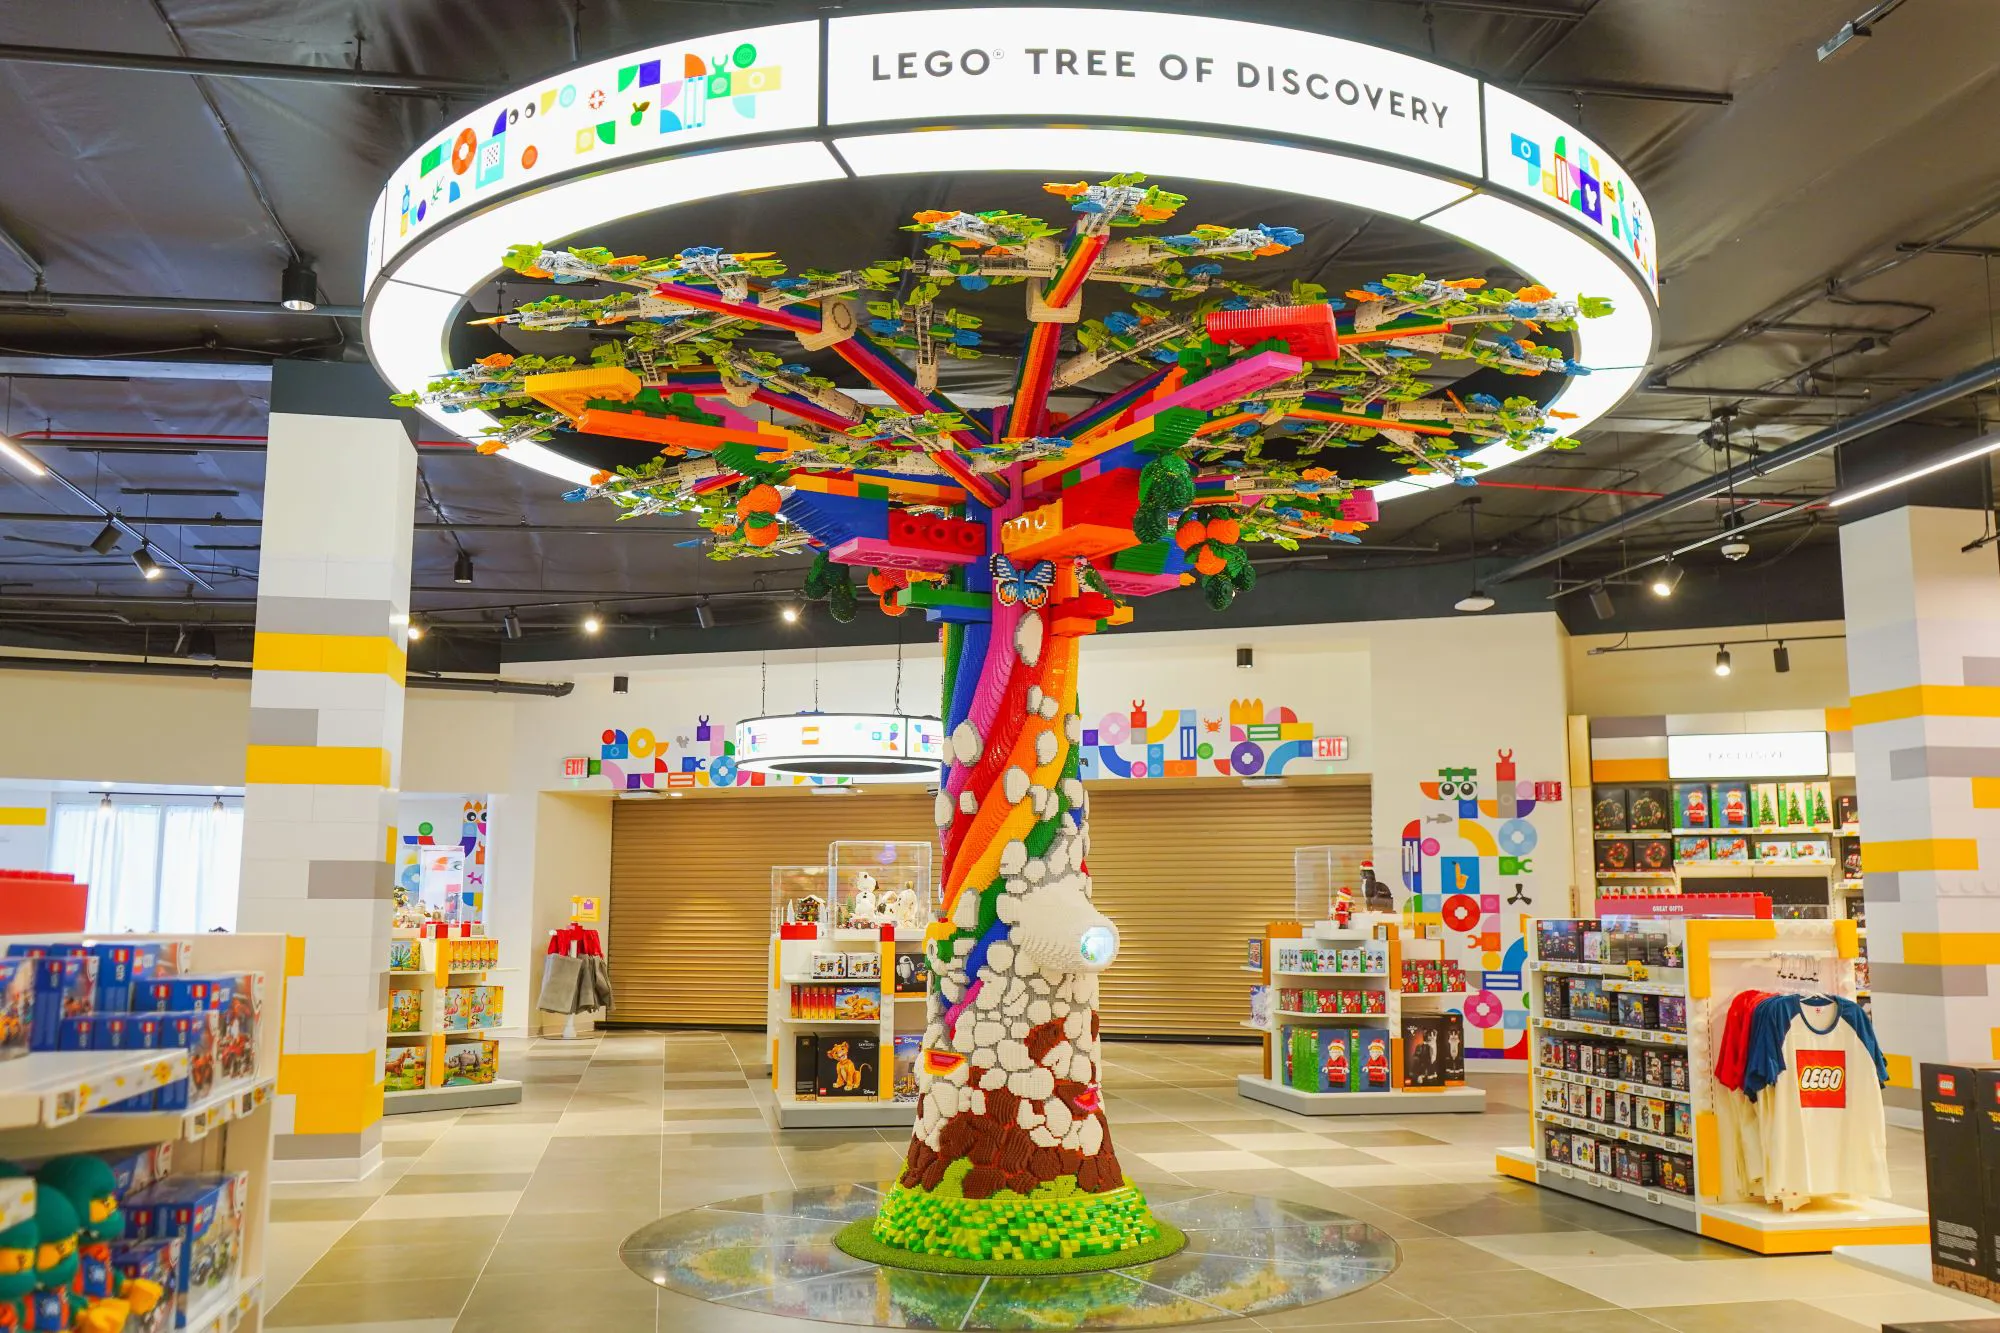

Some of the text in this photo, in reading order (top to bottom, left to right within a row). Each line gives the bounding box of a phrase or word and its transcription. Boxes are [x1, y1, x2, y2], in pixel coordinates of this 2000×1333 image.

[1024, 48, 1136, 78] TREE
[1159, 54, 1214, 83] OF
[1237, 62, 1449, 129] DISCOVERY
[1318, 738, 1342, 756] EXIT
[565, 758, 584, 775] EXIT
[1800, 1067, 1843, 1090] LEGO
